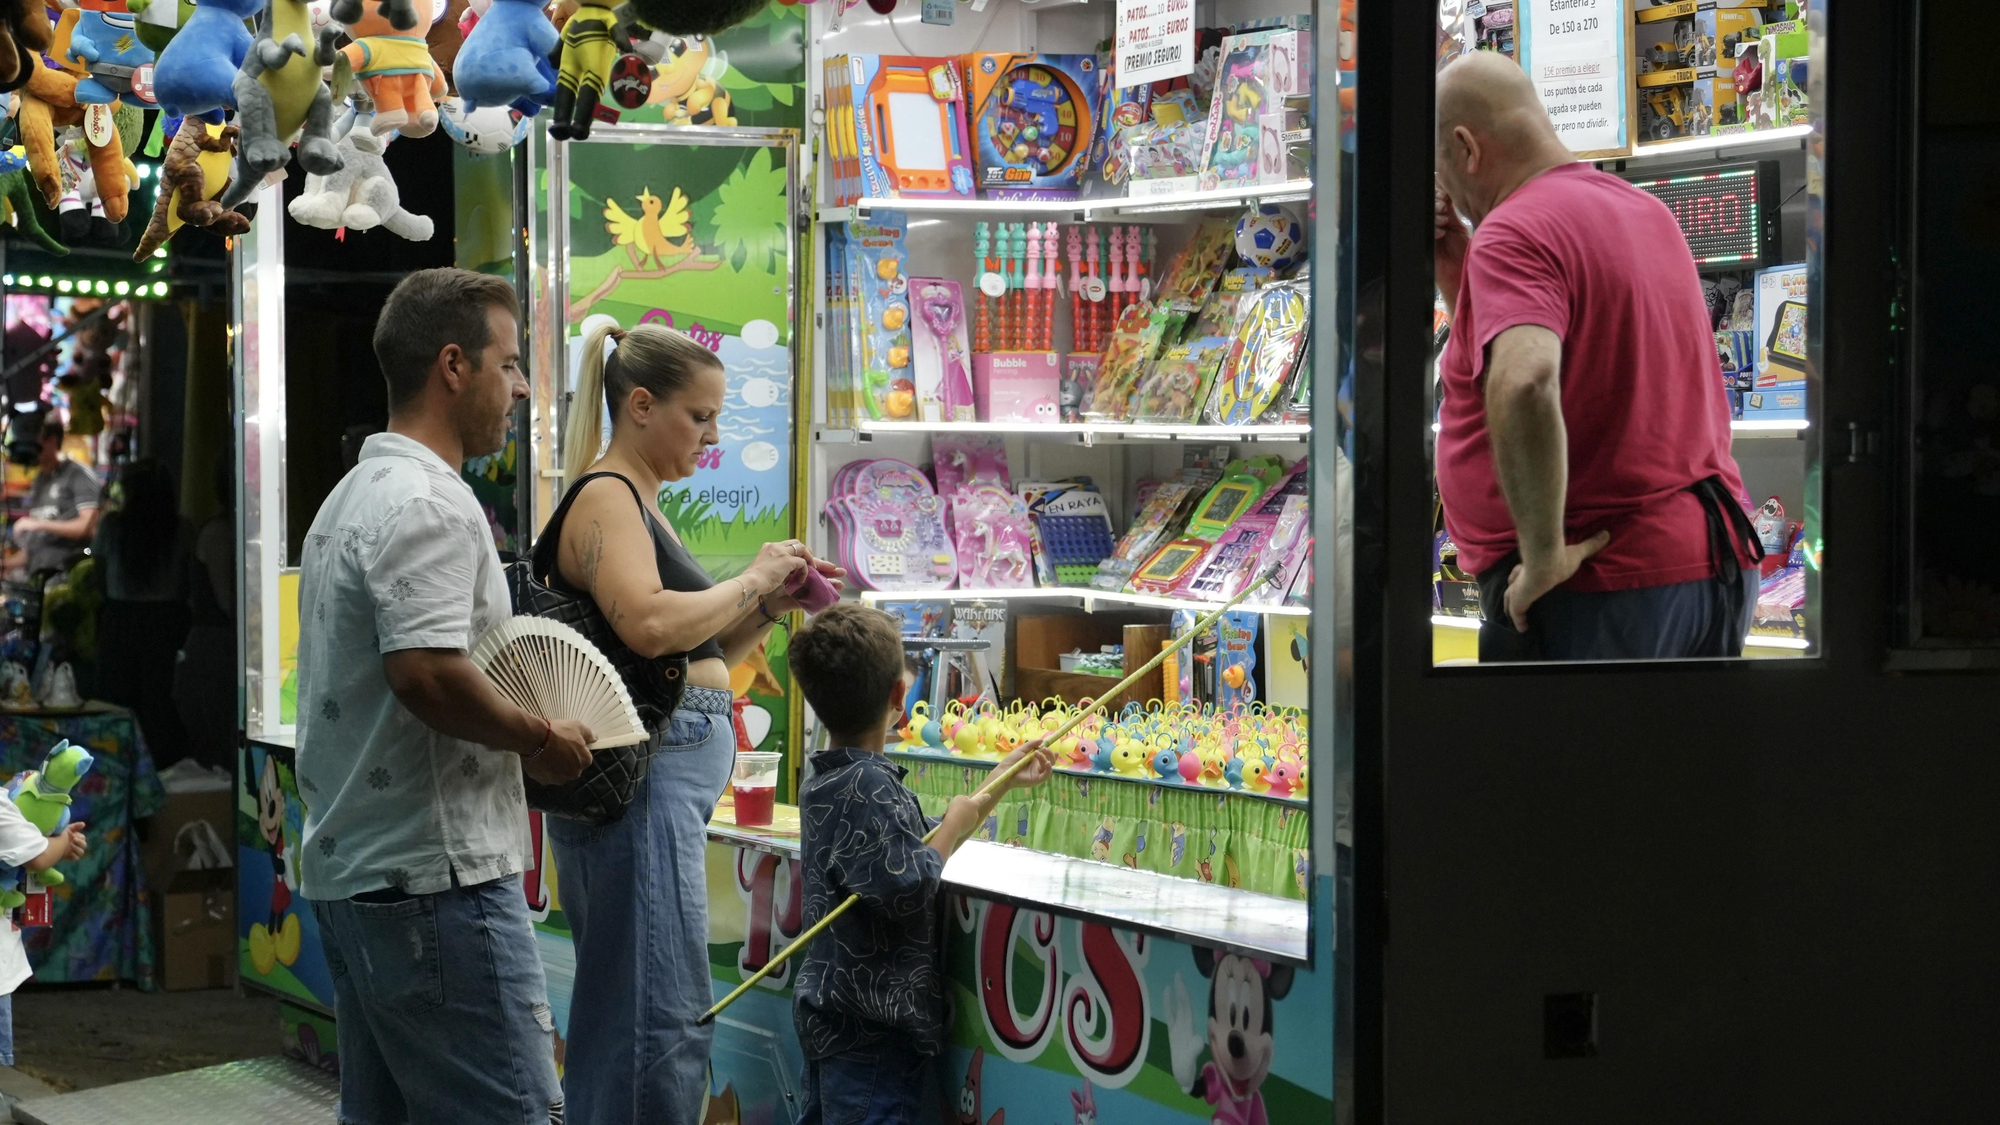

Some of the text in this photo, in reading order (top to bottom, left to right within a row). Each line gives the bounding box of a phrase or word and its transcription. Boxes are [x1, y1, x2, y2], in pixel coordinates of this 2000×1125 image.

[1676, 3, 1694, 13] TRUCK
[1119, 15, 1124, 26] 9
[1549, 17, 1599, 35] De 150 a 270
[1118, 37, 1125, 49] 16
[1166, 17, 1189, 35] EUROS
[1124, 44, 1182, 72] (PREMIO SEGURO)
[1034, 73, 1046, 81] 30
[1543, 67, 1554, 77] 15€
[1555, 66, 1576, 76] premio
[1582, 62, 1600, 75] elegir
[1676, 70, 1693, 80] TRUCK
[1544, 82, 1603, 98] Los puntos de cada
[1547, 101, 1602, 116] jugada se pueden
[1561, 122, 1576, 133] pero
[1577, 121, 1585, 129] no
[1586, 118, 1609, 128] dividir.
[1060, 133, 1072, 141] 10
[1281, 133, 1301, 142] Storms
[850, 207, 855, 222] 3
[993, 358, 1027, 367] Bubble
[681, 490, 691, 503] a
[699, 485, 760, 508] elegir)
[1049, 498, 1102, 514] EN RAYA
[954, 607, 1006, 620] WARFARE
[1221, 622, 1252, 641] Fishing
